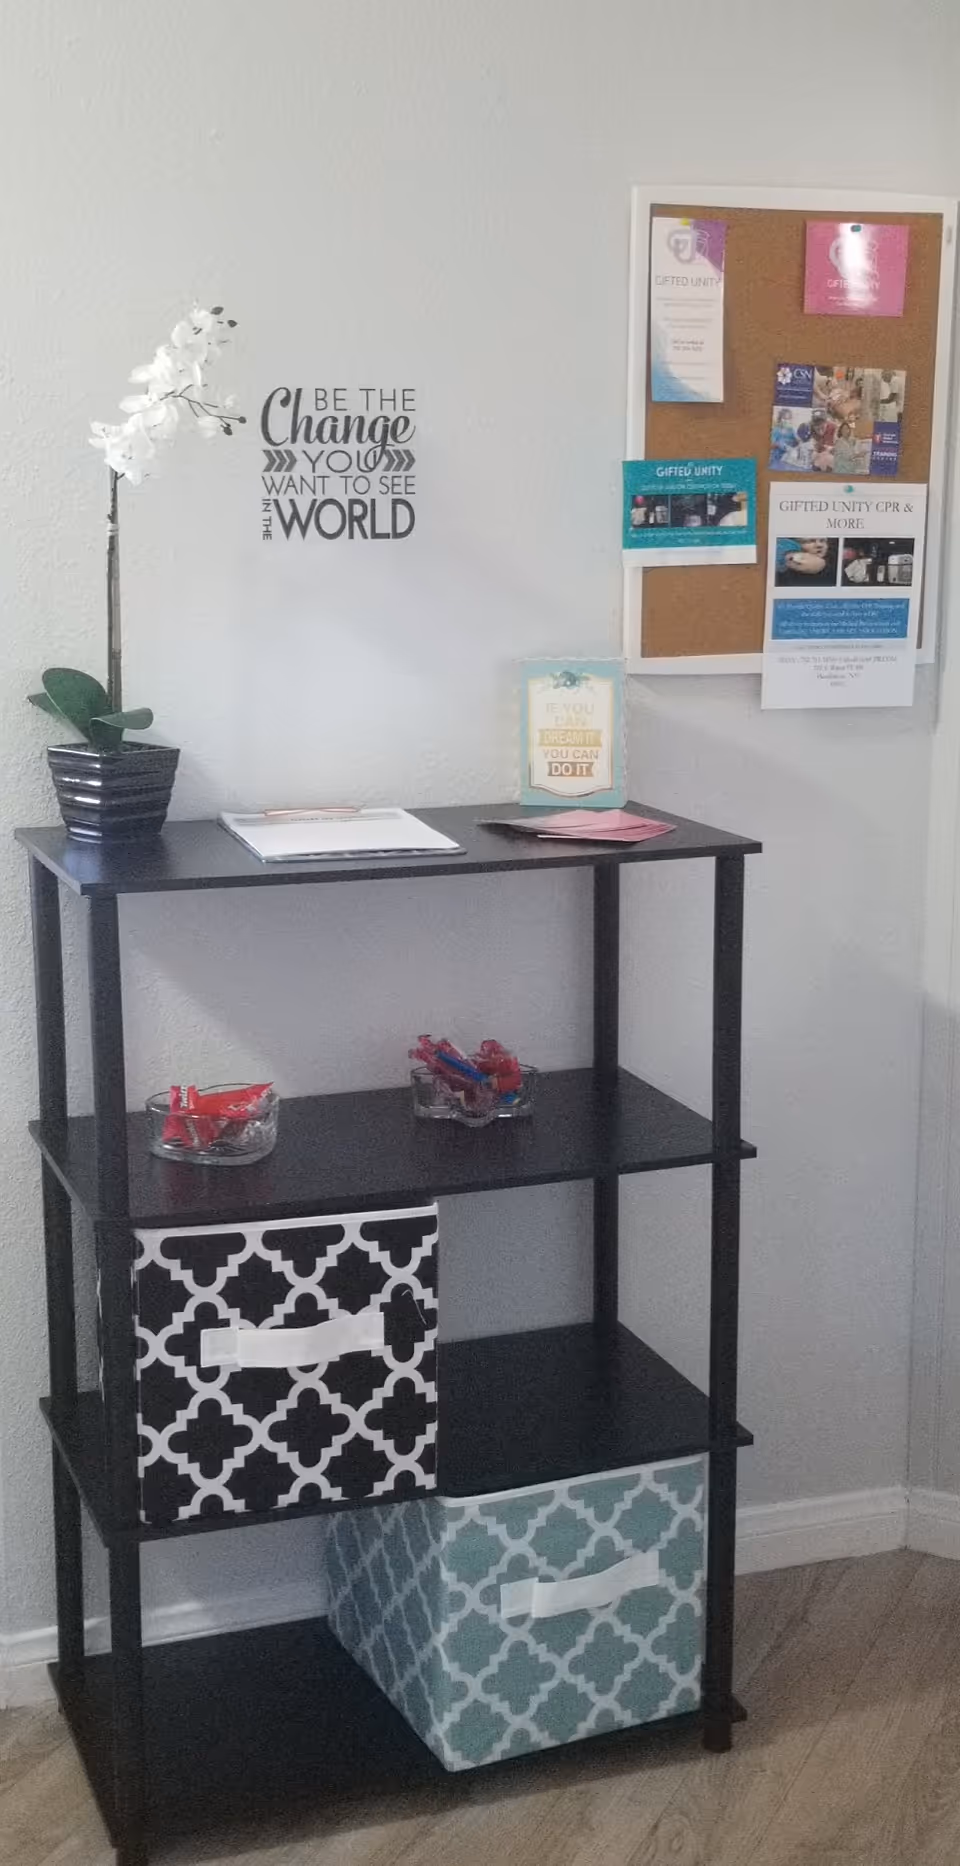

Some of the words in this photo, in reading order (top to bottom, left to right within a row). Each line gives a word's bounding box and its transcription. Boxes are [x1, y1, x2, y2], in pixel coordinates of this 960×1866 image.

[793, 368, 813, 379] CSN
[315, 388, 348, 411] BE
[359, 388, 416, 411] THE
[261, 387, 416, 472] Change
[302, 450, 377, 473] YOU
[656, 466, 692, 477] GIFTED
[695, 465, 723, 476] UNITY
[261, 475, 331, 495] WANT
[339, 475, 371, 495] TO
[379, 475, 416, 495] SEE
[262, 499, 272, 512] IN
[779, 500, 829, 512] GIFTED
[832, 501, 873, 512] UNITY
[875, 501, 900, 512] CPR
[903, 503, 914, 512] &
[272, 498, 415, 540] WORLD
[826, 518, 865, 529] MORE
[262, 516, 272, 540] THE
[562, 703, 595, 714] YOU
[543, 749, 569, 759] YOU
[572, 749, 599, 760] CAN
[551, 763, 572, 775] DO
[576, 763, 589, 775] IT
